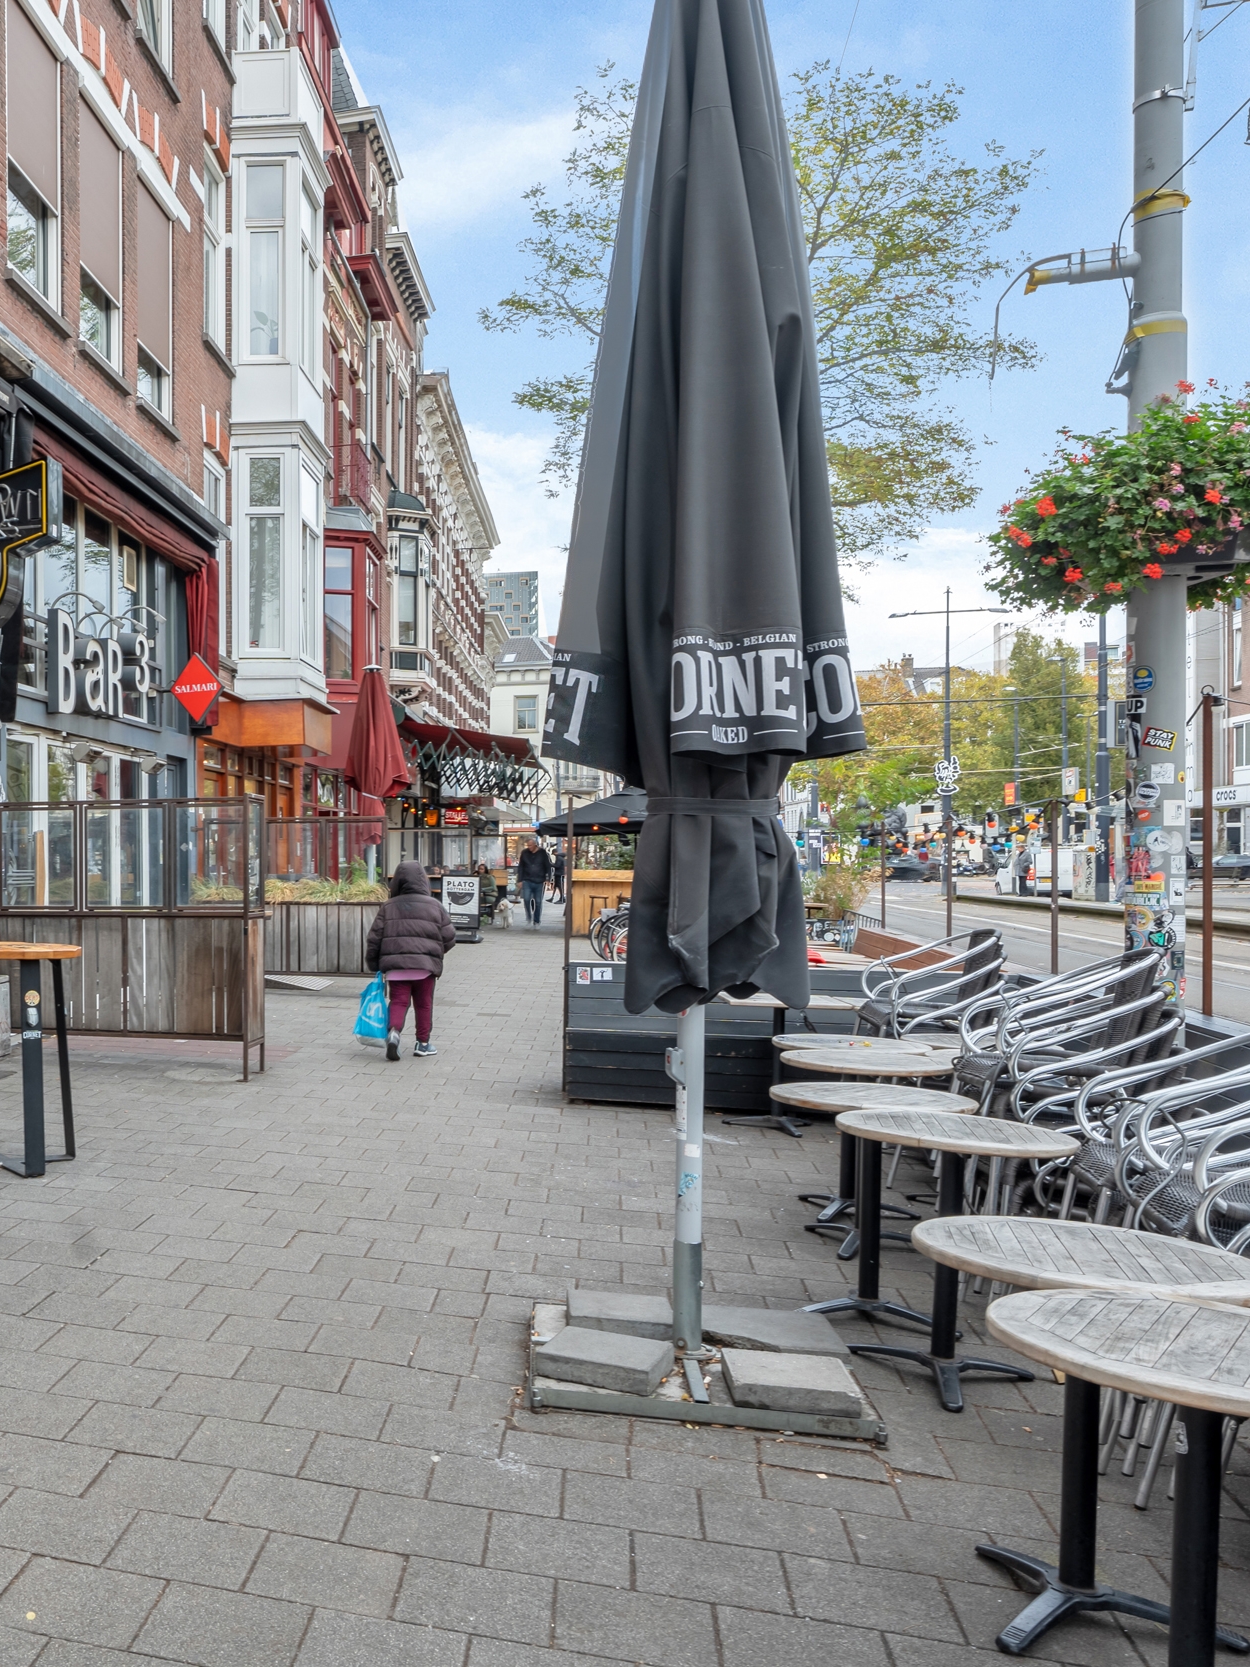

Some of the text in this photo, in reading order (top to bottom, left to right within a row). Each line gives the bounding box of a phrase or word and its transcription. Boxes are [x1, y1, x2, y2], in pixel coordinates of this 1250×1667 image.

[743, 633, 797, 647] BELGIAN
[174, 682, 218, 694] SALMARI
[671, 649, 802, 721] ORNE
[712, 724, 748, 744] OAKED
[1147, 728, 1175, 739] STAY
[1144, 737, 1172, 749] PUNK
[1216, 789, 1237, 801] crocs
[446, 880, 475, 888] PLATO
